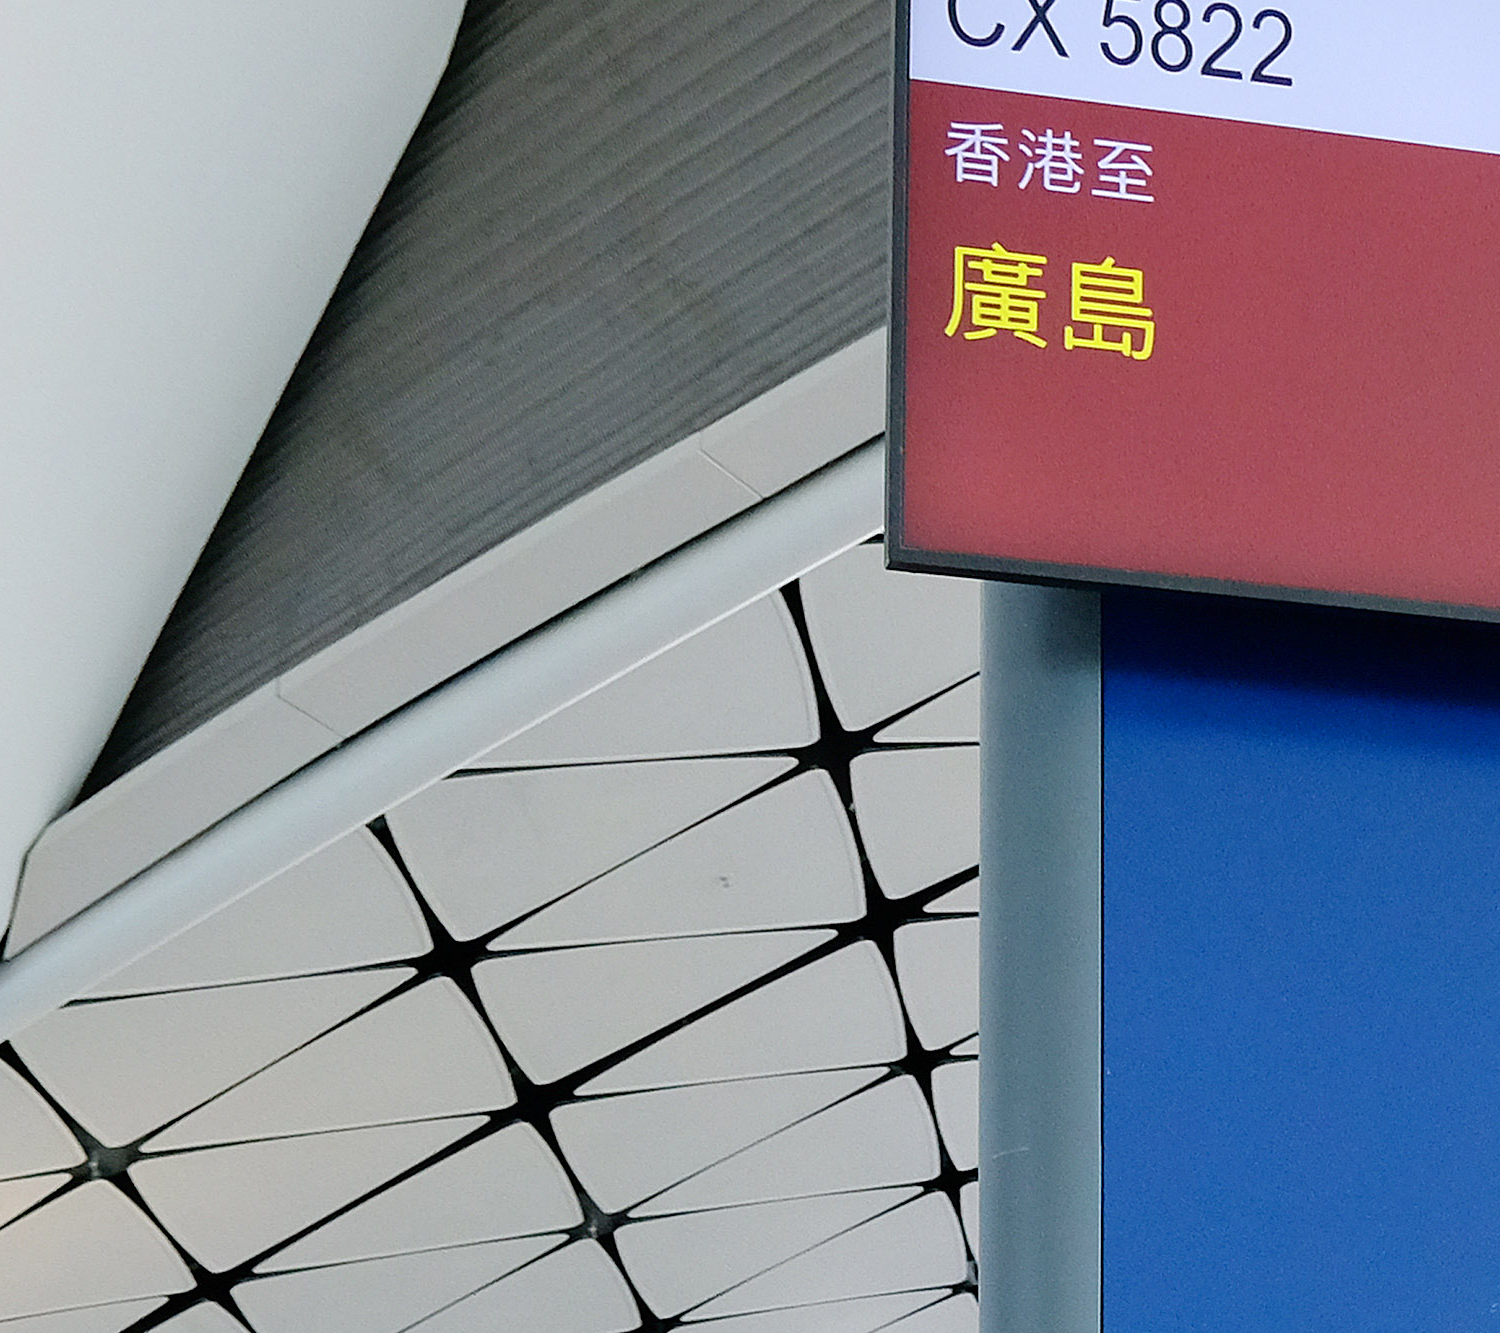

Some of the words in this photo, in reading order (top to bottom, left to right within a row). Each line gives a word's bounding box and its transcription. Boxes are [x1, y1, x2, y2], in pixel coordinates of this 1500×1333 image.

[1100, 0, 1293, 87] 5822
[944, 120, 1156, 203] 香港至
[944, 242, 1156, 361] 廣島
